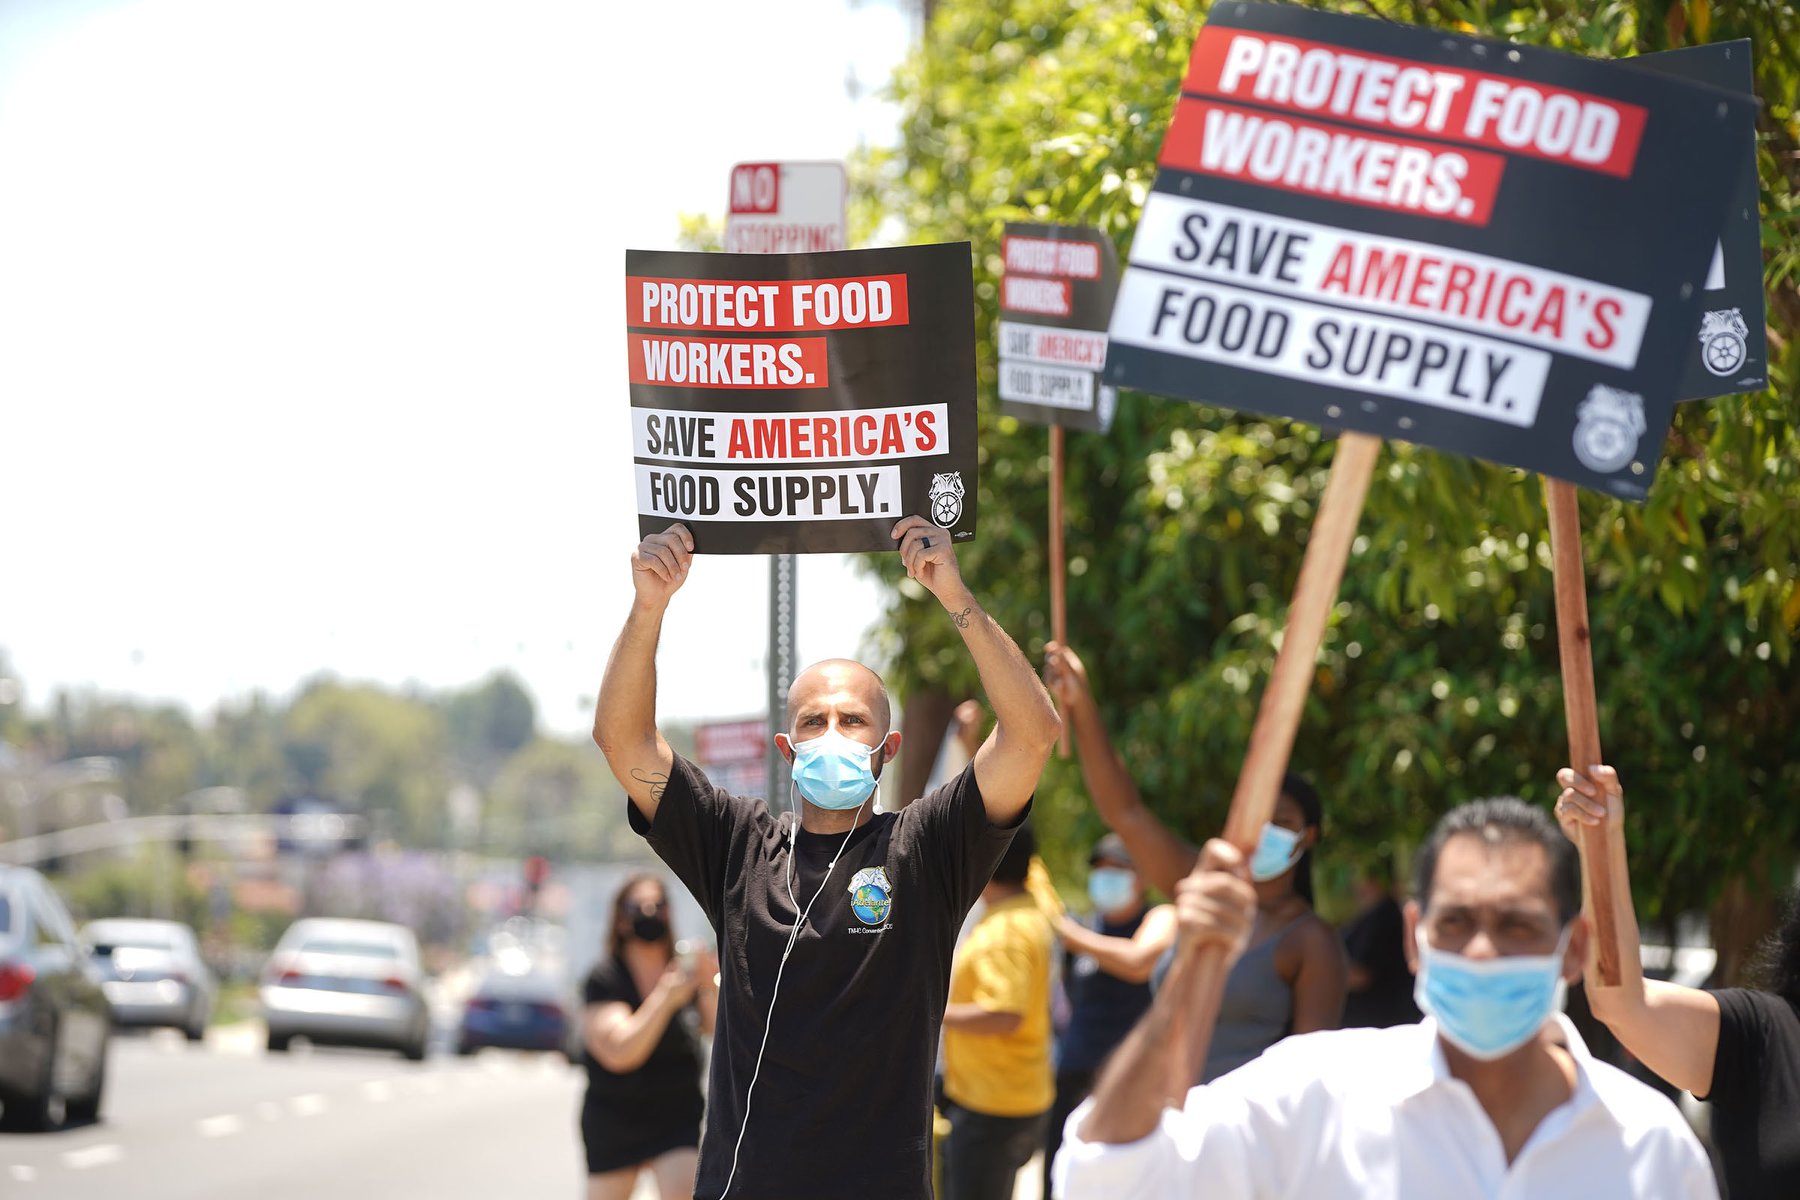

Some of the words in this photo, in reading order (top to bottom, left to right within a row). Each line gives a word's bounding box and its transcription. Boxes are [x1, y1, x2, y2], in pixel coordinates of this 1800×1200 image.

[1217, 34, 1466, 133] PROTECT
[1463, 78, 1620, 164] FOOD
[1200, 108, 1476, 218] WORKERS.
[733, 166, 776, 211] NO
[642, 282, 780, 327] PROTECT
[792, 280, 893, 326] FOOD
[1174, 213, 1310, 284] SAVE
[1319, 243, 1624, 351] AMERICA'S
[642, 339, 815, 385] WORKERS.
[1151, 288, 1290, 360] FOOD
[1306, 321, 1515, 410] SUPPLY.
[647, 414, 716, 458] SAVE
[727, 410, 938, 459] AMERICA'S
[650, 471, 720, 516] FOOD
[733, 472, 889, 517] SUPPLY.
